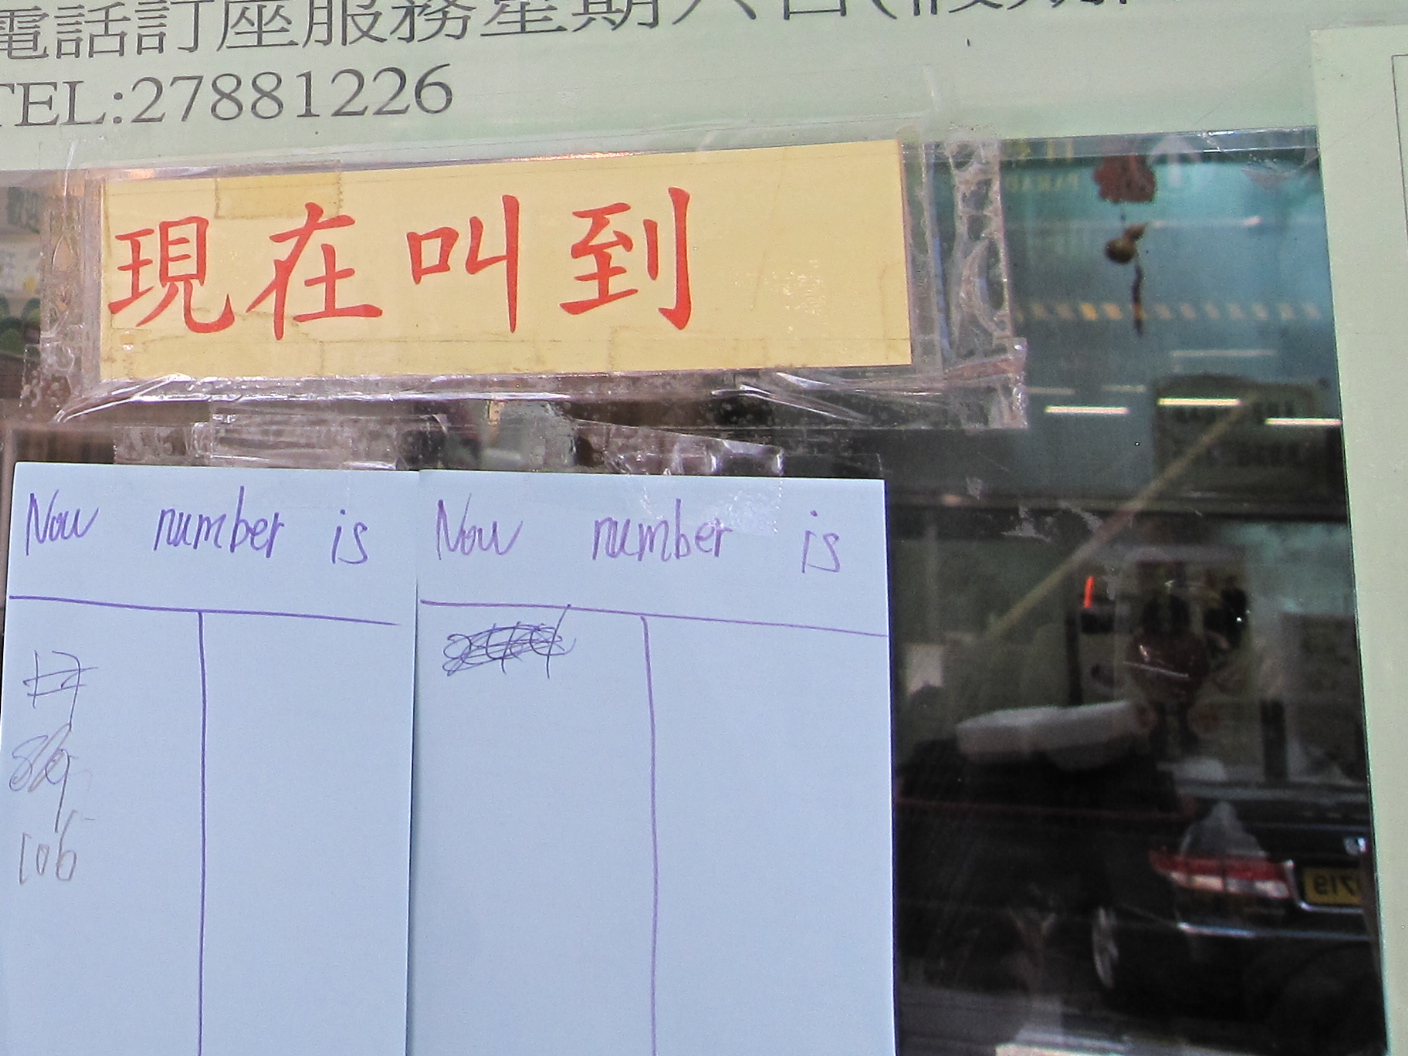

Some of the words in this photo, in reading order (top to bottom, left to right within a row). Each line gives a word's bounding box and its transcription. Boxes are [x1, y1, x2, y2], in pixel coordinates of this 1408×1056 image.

[107, 186, 694, 340] 現在叫到
[24, 491, 100, 551] Now
[154, 486, 285, 559] number
[330, 507, 369, 565] is
[436, 496, 524, 559] Now
[592, 491, 734, 561] number
[800, 508, 840, 573] is
